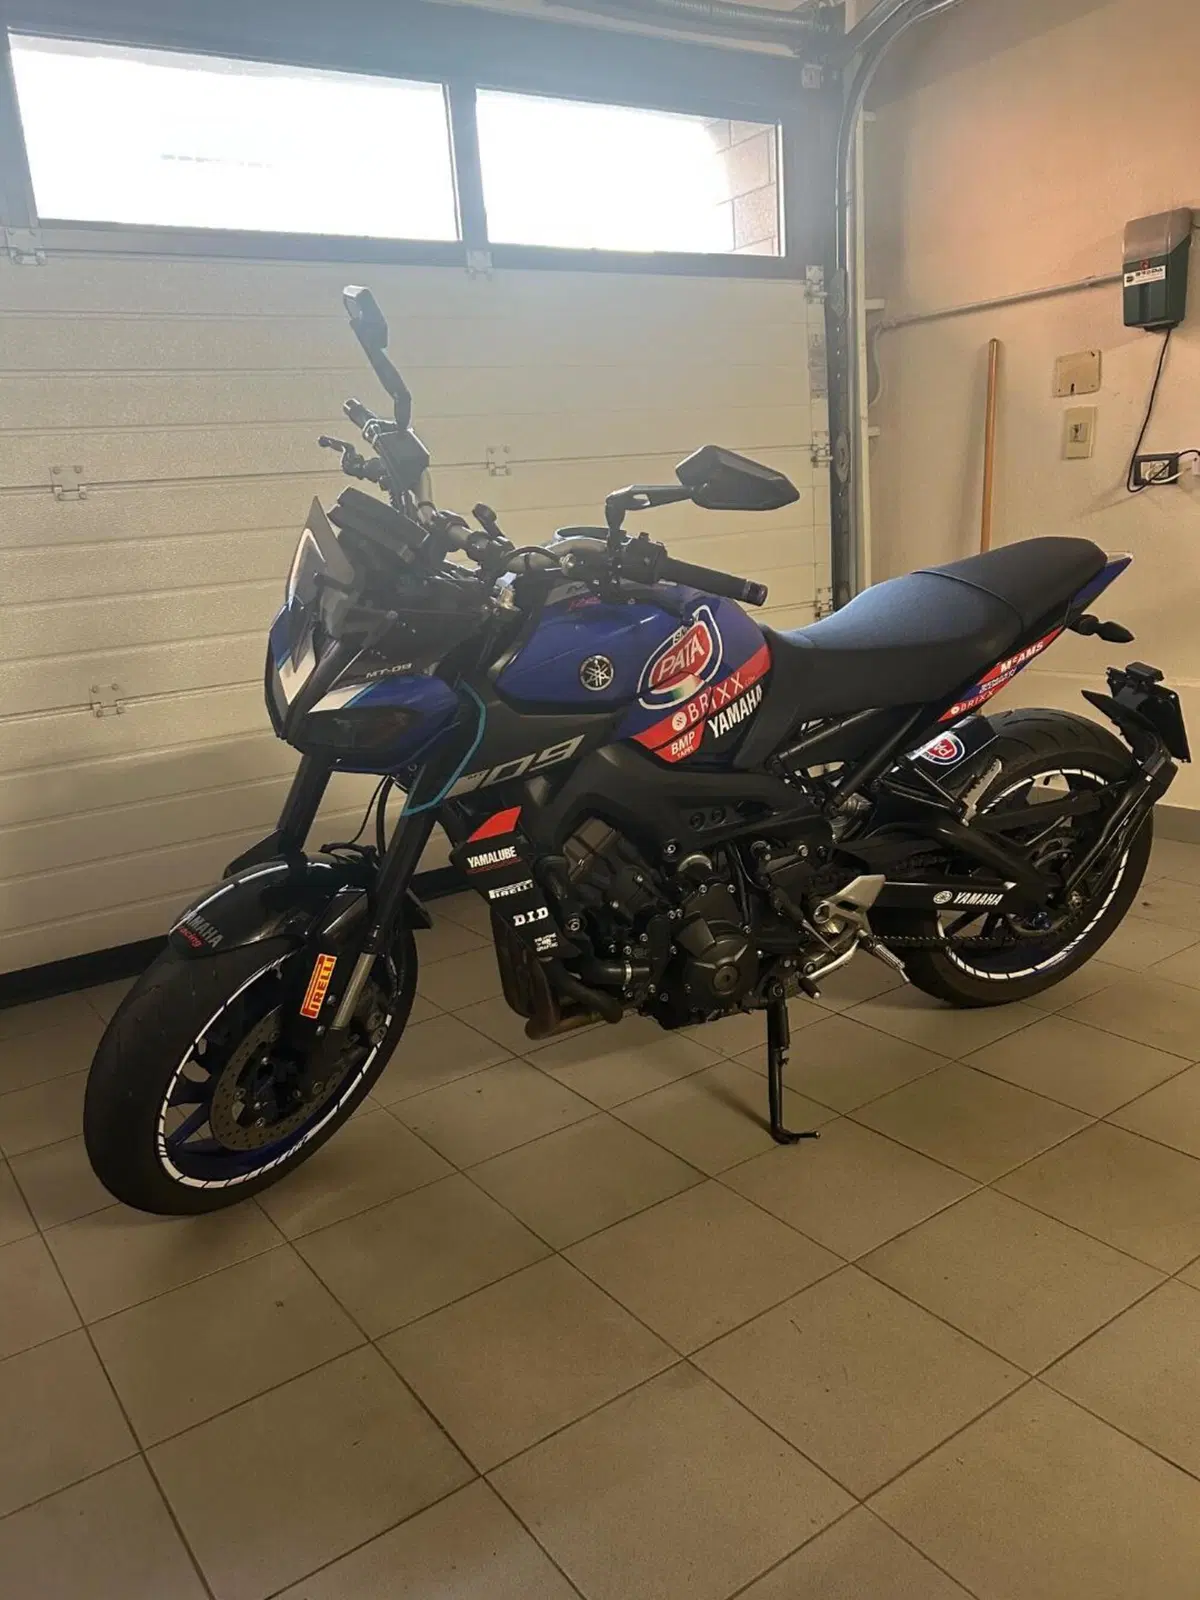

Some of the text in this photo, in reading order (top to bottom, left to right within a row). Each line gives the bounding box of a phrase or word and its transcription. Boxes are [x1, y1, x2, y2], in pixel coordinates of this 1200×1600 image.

[657, 633, 705, 682] PATA
[688, 671, 744, 722] BRIXX
[707, 683, 763, 738] YAMAHA
[671, 731, 695, 756] BMP
[467, 845, 518, 869] YAMALUBE
[488, 879, 534, 899] PIRELLI
[952, 891, 1004, 906] YAMAHA
[180, 909, 224, 949] AMAHA
[302, 955, 336, 1017] PIRELLI
